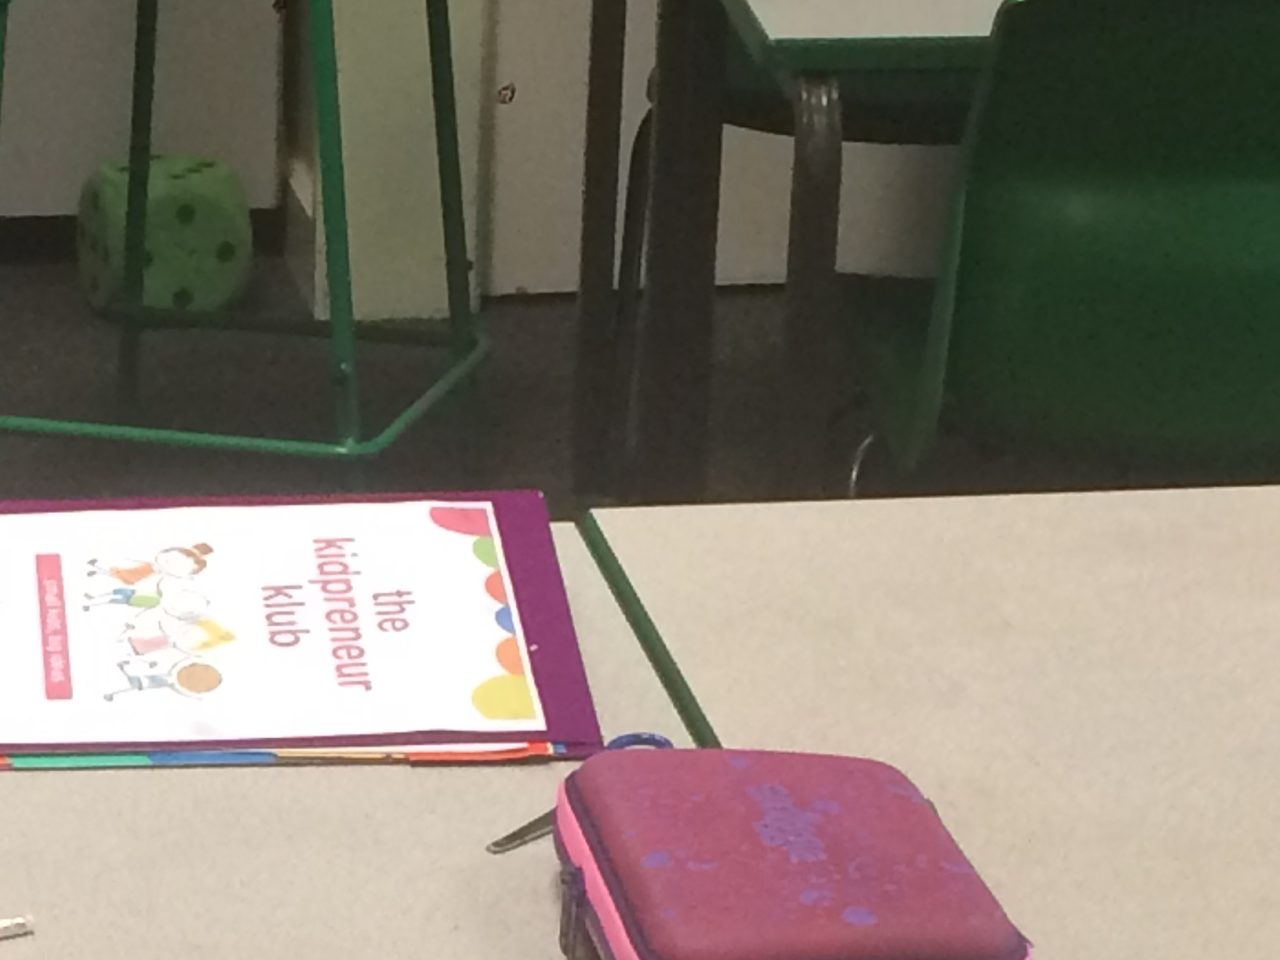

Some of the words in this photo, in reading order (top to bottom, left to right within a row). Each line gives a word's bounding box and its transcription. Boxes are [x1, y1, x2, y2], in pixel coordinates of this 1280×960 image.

[261, 585, 310, 647] klub
[307, 538, 372, 691] kidpreneur
[372, 590, 415, 632] the
